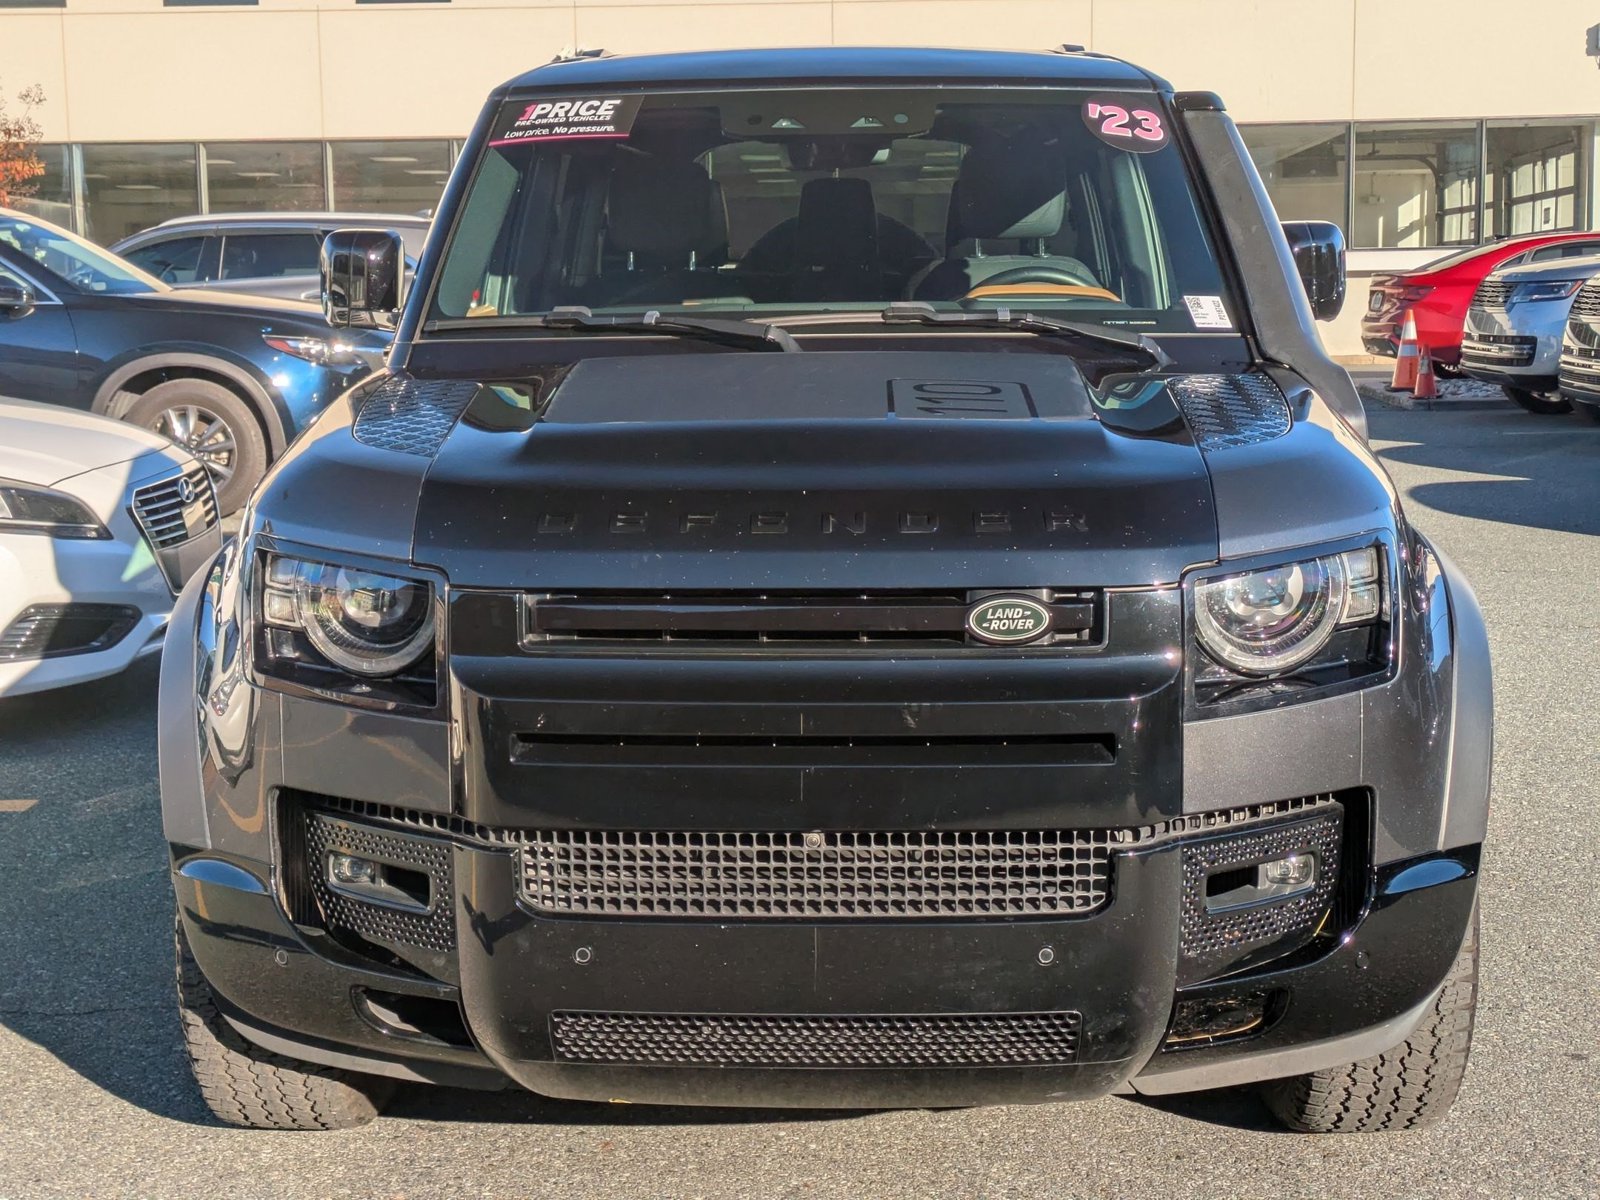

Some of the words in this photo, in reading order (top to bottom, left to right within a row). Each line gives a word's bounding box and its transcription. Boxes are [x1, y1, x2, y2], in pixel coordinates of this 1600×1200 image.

[518, 100, 621, 121] 1PRICE
[515, 118, 566, 127] PRE-OWNED
[1088, 103, 1163, 140] '23
[504, 129, 525, 139] Low
[524, 127, 550, 138] price.
[552, 125, 569, 134] No
[569, 125, 615, 134] pressure.
[537, 510, 1089, 534] DEFENDER
[987, 608, 1022, 619] LAND
[990, 619, 1034, 630] ROVER
